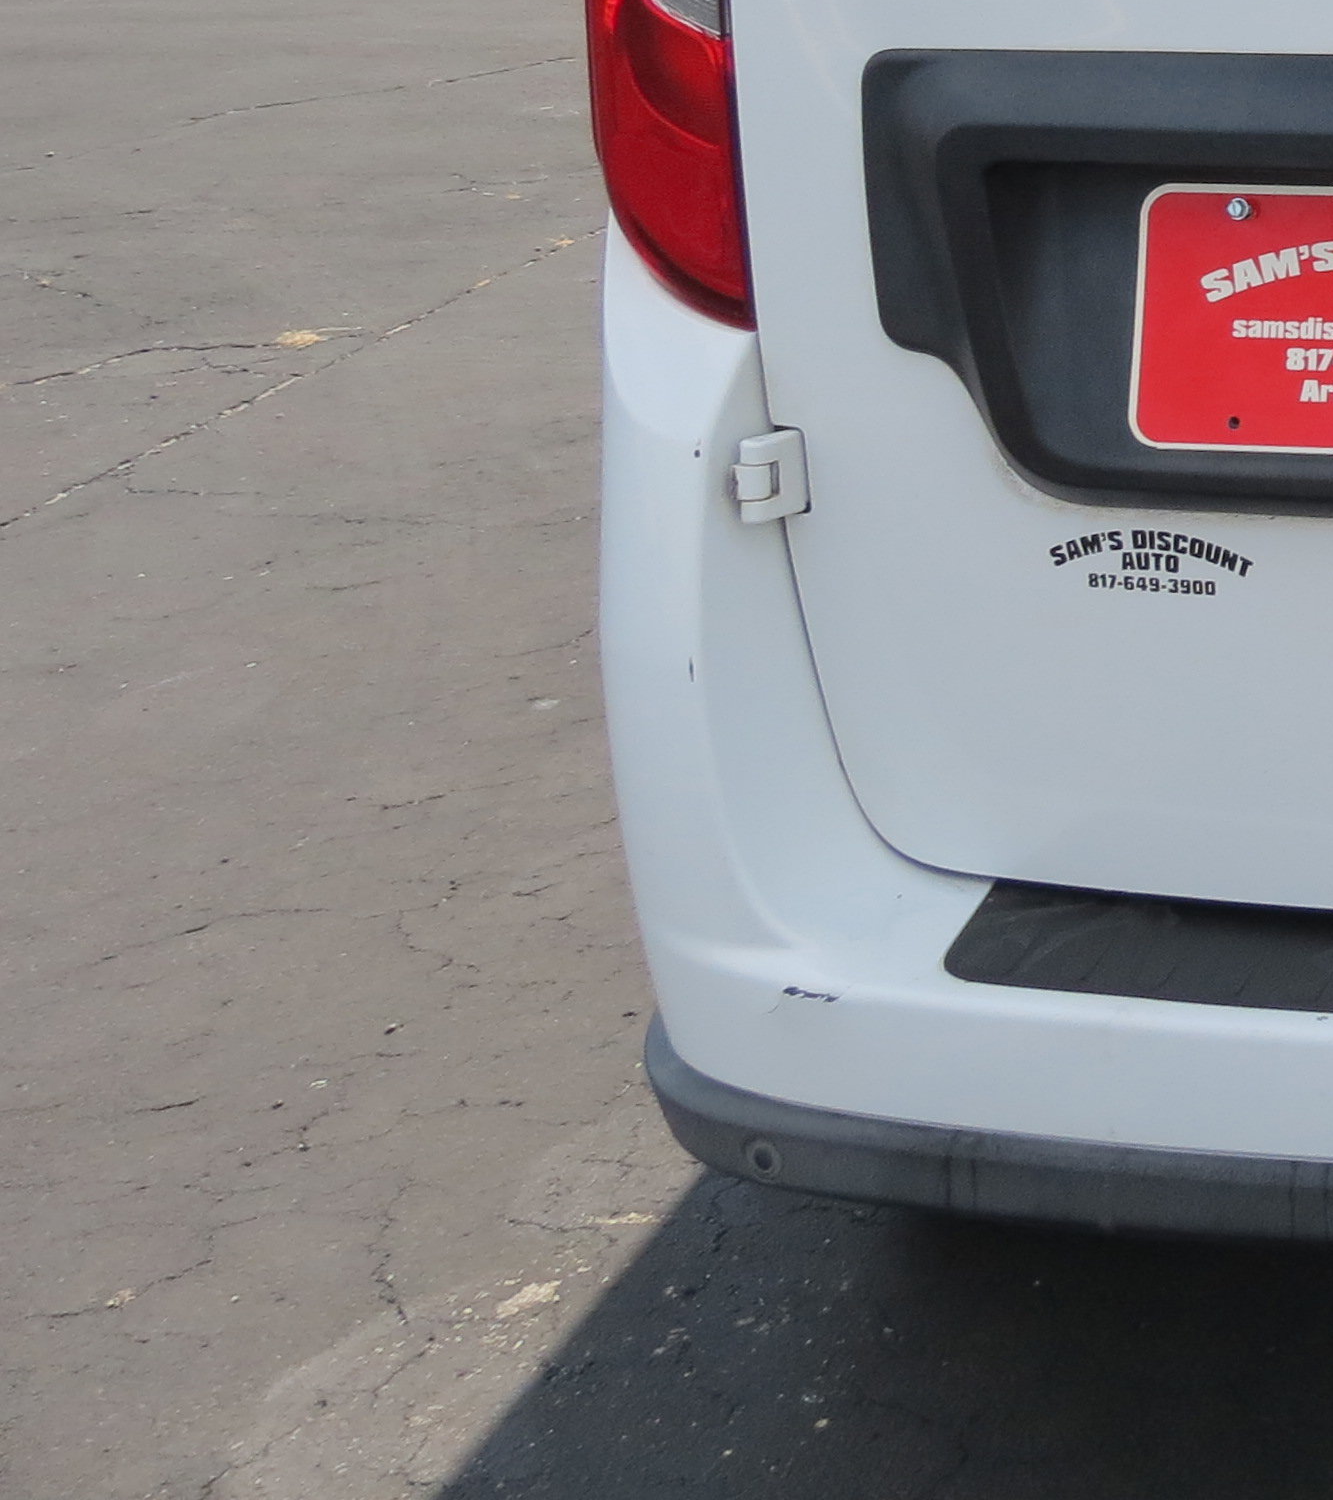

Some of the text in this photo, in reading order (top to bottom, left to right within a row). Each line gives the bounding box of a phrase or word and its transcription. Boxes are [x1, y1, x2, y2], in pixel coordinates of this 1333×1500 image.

[1049, 529, 1254, 578] SAM'S DISCOUNT
[1121, 551, 1180, 574] AUTO
[1088, 573, 1216, 596] 817-649-3900
